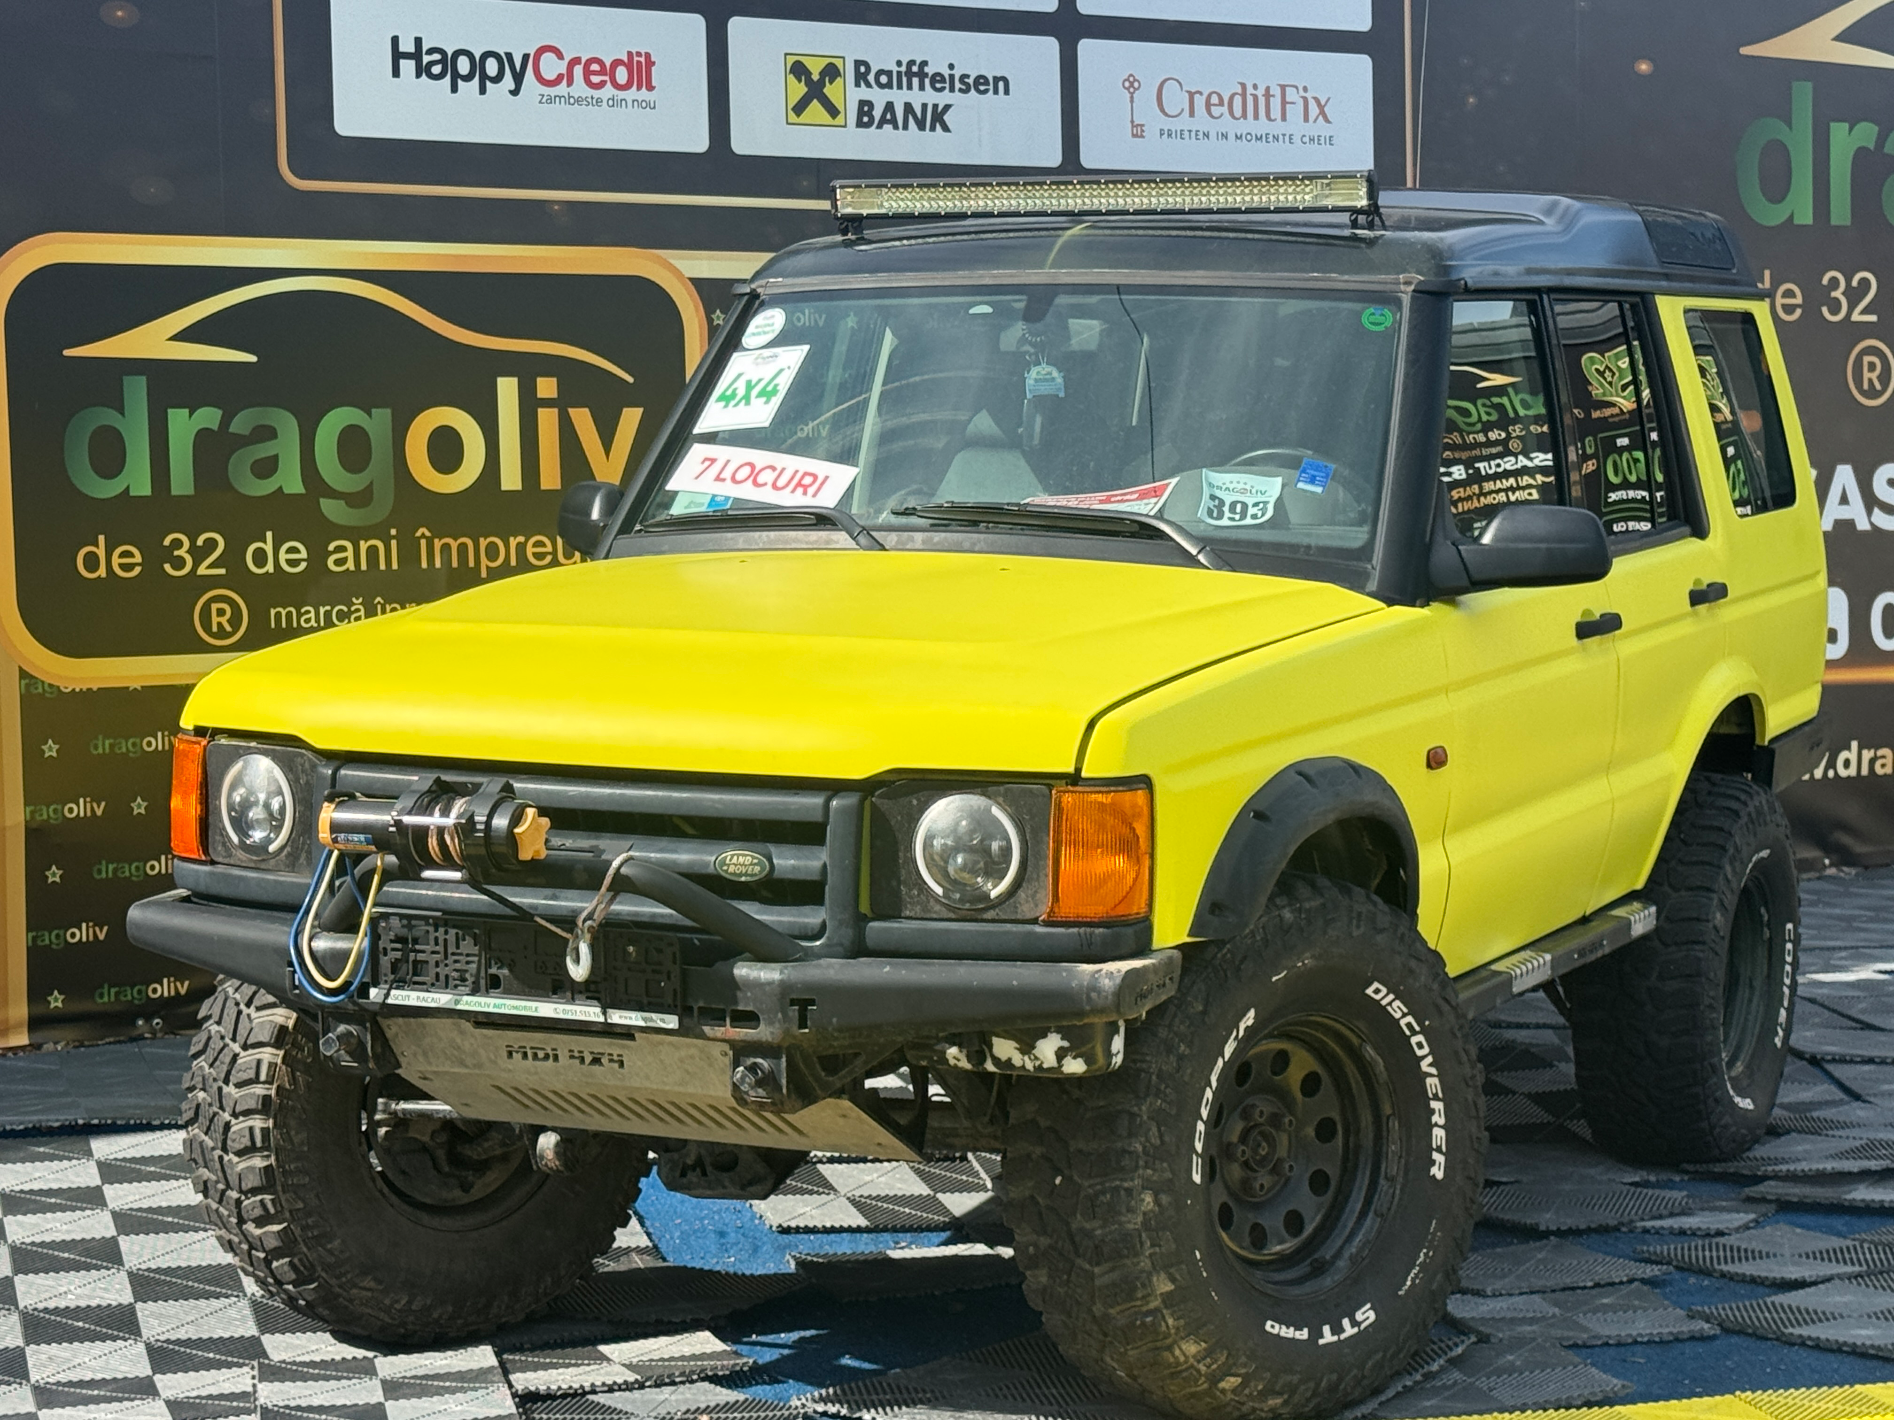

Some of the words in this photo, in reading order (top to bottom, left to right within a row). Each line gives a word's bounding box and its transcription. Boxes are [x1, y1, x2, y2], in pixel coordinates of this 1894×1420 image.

[391, 35, 656, 97] HappyCredit
[854, 59, 1010, 96] Raiffeisen
[538, 92, 603, 108] zambeste
[606, 95, 628, 109] din
[632, 97, 656, 110] nou
[855, 99, 954, 133] BANK
[1156, 77, 1332, 124] CreditFix
[1159, 128, 1210, 141] PRIETEN
[1216, 131, 1229, 142] IN
[1234, 132, 1294, 145] MOMENTE
[1300, 134, 1335, 146] CHEIE
[1821, 270, 1878, 322] 32
[63, 374, 644, 527] dragoliv
[694, 457, 718, 480] 7
[713, 459, 830, 498] LOCURI
[1206, 493, 1271, 523] 393
[77, 534, 142, 579] de
[162, 532, 227, 577] 32
[246, 531, 308, 574] de
[326, 529, 399, 572] ani
[414, 527, 590, 578] împreu
[90, 731, 175, 757] dragoli
[726, 855, 752, 865] LAND
[728, 865, 760, 874] ROVER
[95, 977, 190, 1005] dragoliv
[1774, 922, 1794, 1049] COOPER
[1192, 1008, 1256, 1185] COOPER
[1364, 981, 1446, 1181] DISCOVERER
[1265, 1320, 1308, 1340] PRO
[1318, 1302, 1376, 1345] STT
